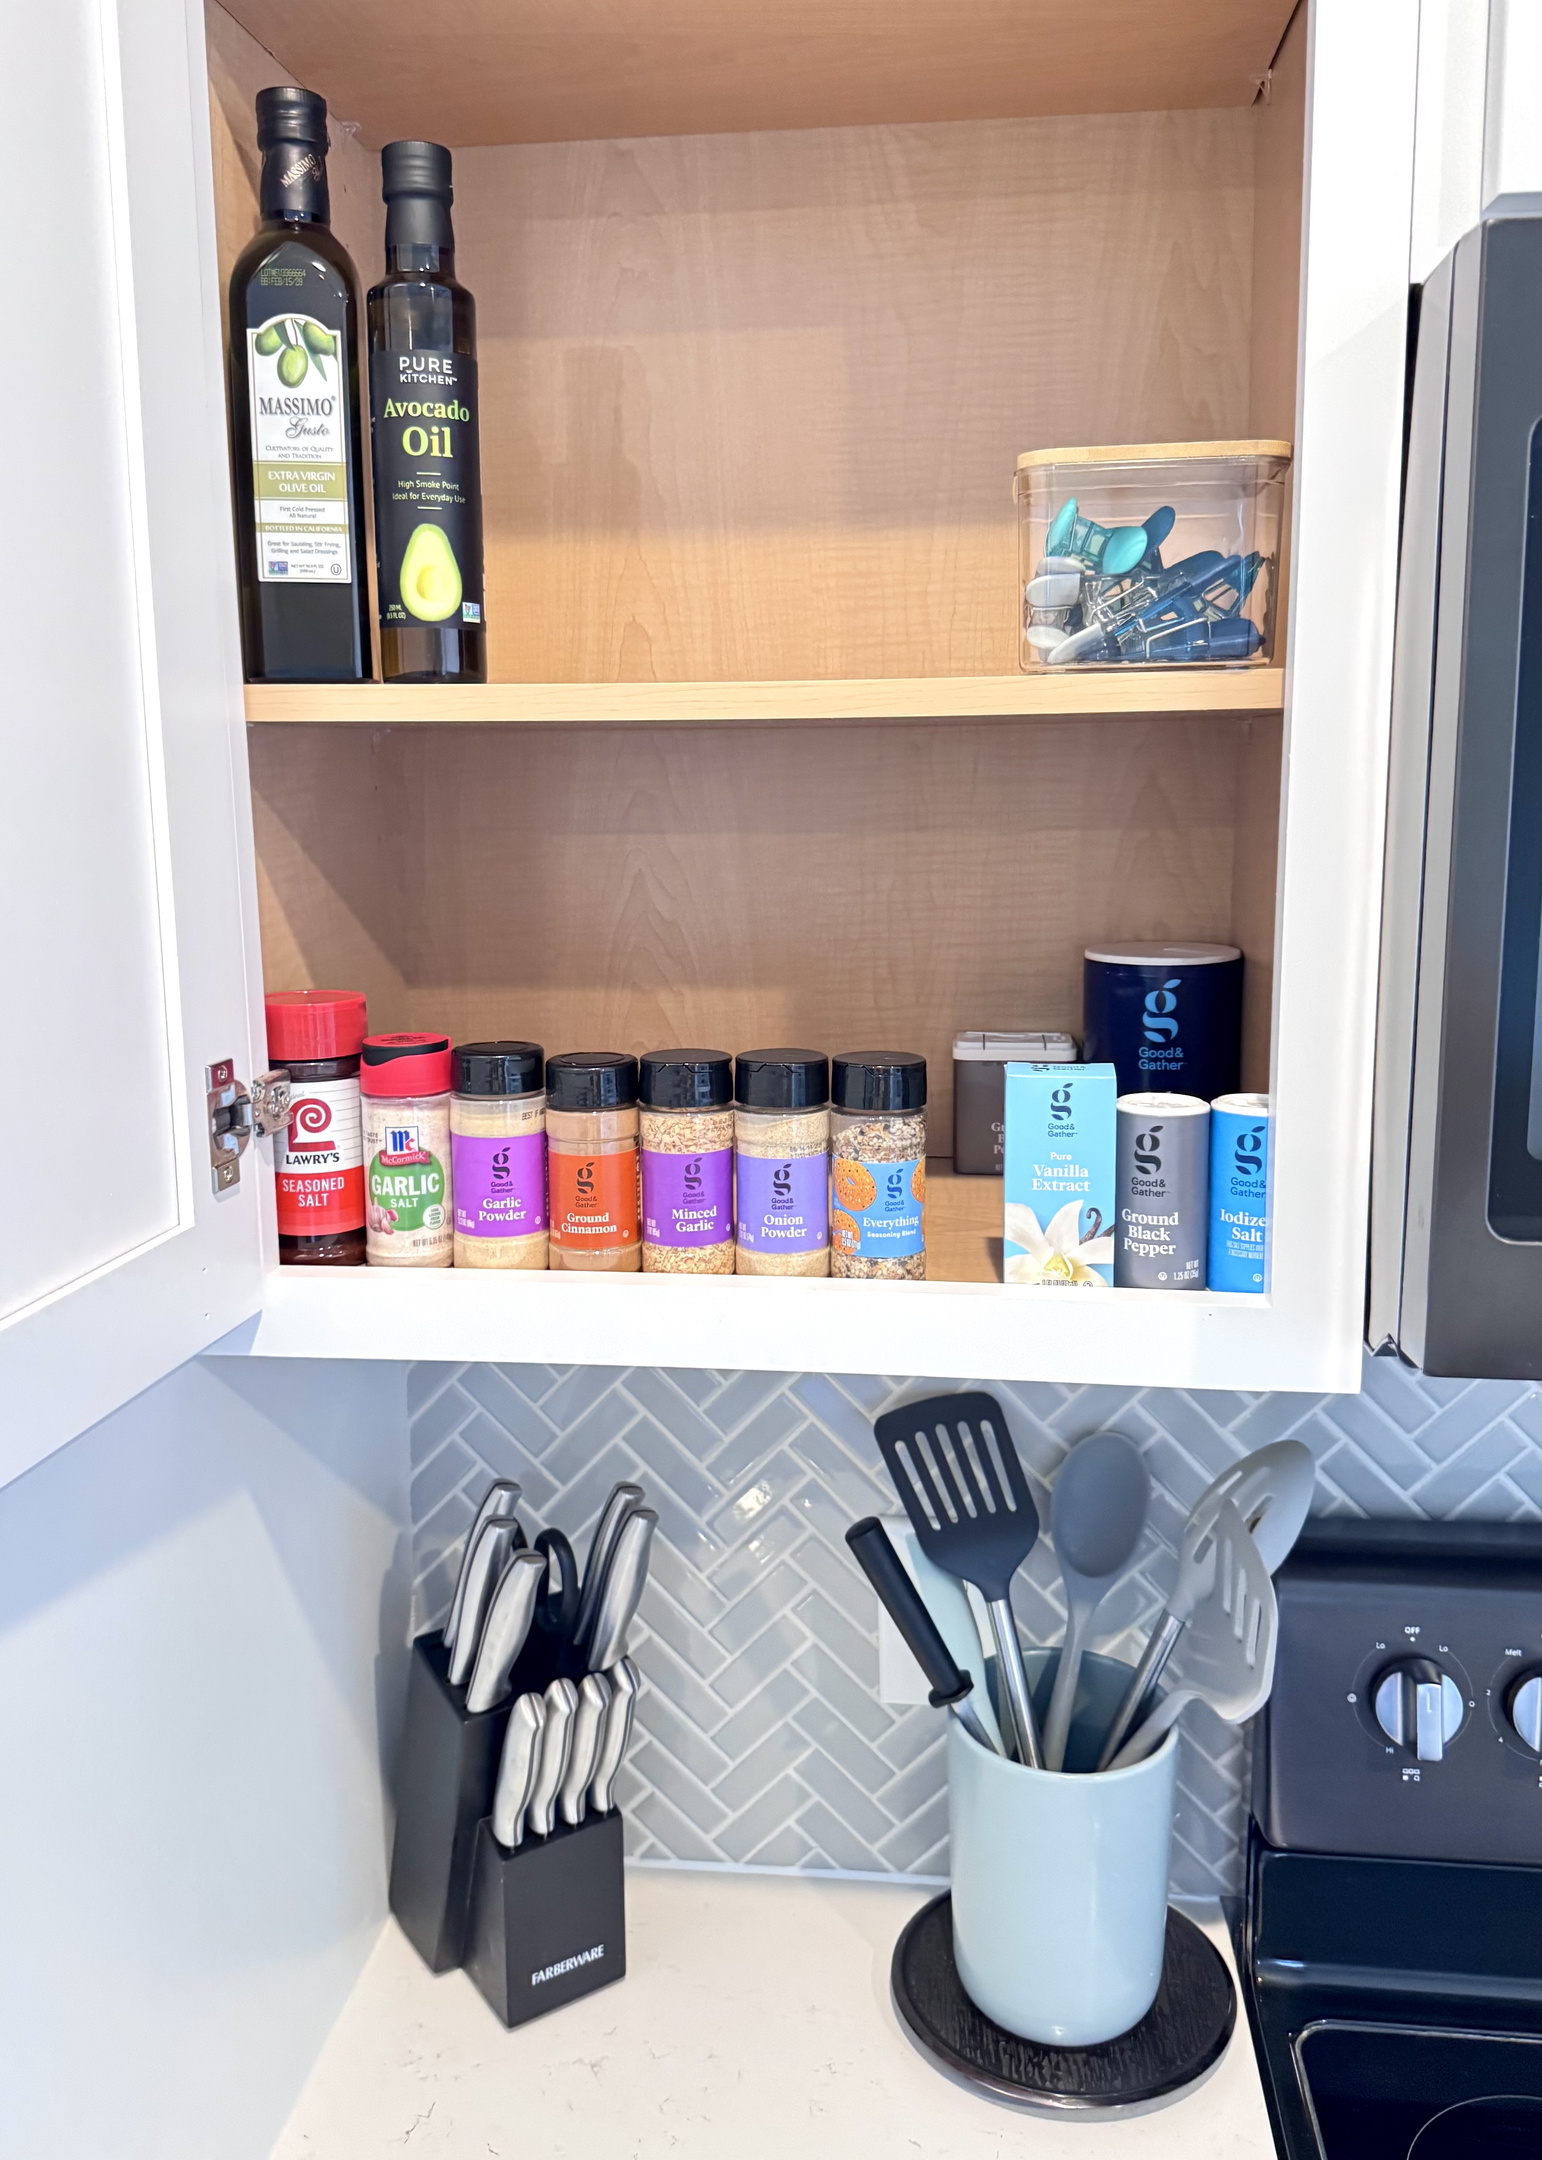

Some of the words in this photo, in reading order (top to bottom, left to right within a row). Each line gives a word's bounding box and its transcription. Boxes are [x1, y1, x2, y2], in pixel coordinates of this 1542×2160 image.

[280, 153, 316, 188] MASSIMO
[399, 356, 453, 374] PURE
[400, 371, 453, 385] KITCHEN
[259, 396, 334, 416] MASSIMO
[383, 398, 470, 422] Avocado
[285, 416, 331, 439] Gusto
[402, 425, 453, 458] Oil
[268, 471, 300, 481] EXTRA
[300, 471, 336, 482] VIRGIN
[279, 483, 308, 493] OLIVE
[309, 483, 326, 494] OIL
[398, 480, 414, 490] High
[416, 479, 440, 489] Smoke
[441, 481, 460, 491] Point
[392, 492, 408, 501] Ideal
[409, 492, 420, 500] for
[421, 492, 453, 504] Everyday
[1138, 1058, 1184, 1071] Gather
[1048, 1130, 1075, 1138] Gather
[286, 1152, 340, 1165] LAWRY'S
[381, 1151, 426, 1164] McCormick
[1050, 1152, 1072, 1161] Pure
[1033, 1163, 1089, 1178] Vanilla
[282, 1176, 344, 1193] SEASONED
[371, 1173, 440, 1196] GARLIC
[1032, 1178, 1091, 1192] Extract
[1131, 1186, 1166, 1198] Gather
[298, 1193, 329, 1207] SALT
[391, 1197, 419, 1208] SALT
[482, 1197, 522, 1209] Garlic
[478, 1209, 526, 1222] Powder
[567, 1212, 609, 1223] Ground
[672, 1205, 717, 1220] Minced
[1121, 1208, 1179, 1226] Ground
[675, 1219, 714, 1233] Garlic
[764, 1214, 804, 1226] Onion
[863, 1215, 919, 1230] Everything
[561, 1222, 617, 1234] Cinnamon
[761, 1226, 807, 1239] Powder
[867, 1230, 900, 1239] Seasoning
[901, 1228, 916, 1237] Blend
[1128, 1224, 1171, 1241] Black
[1231, 1226, 1263, 1243] Salt
[1123, 1237, 1177, 1258] Pepper
[1404, 1626, 1420, 1635] OFF
[1376, 1642, 1386, 1650] Lo
[1439, 1645, 1449, 1653] Lo
[1505, 1648, 1522, 1657] Melt
[531, 1944, 604, 1986] FARBERWARE
